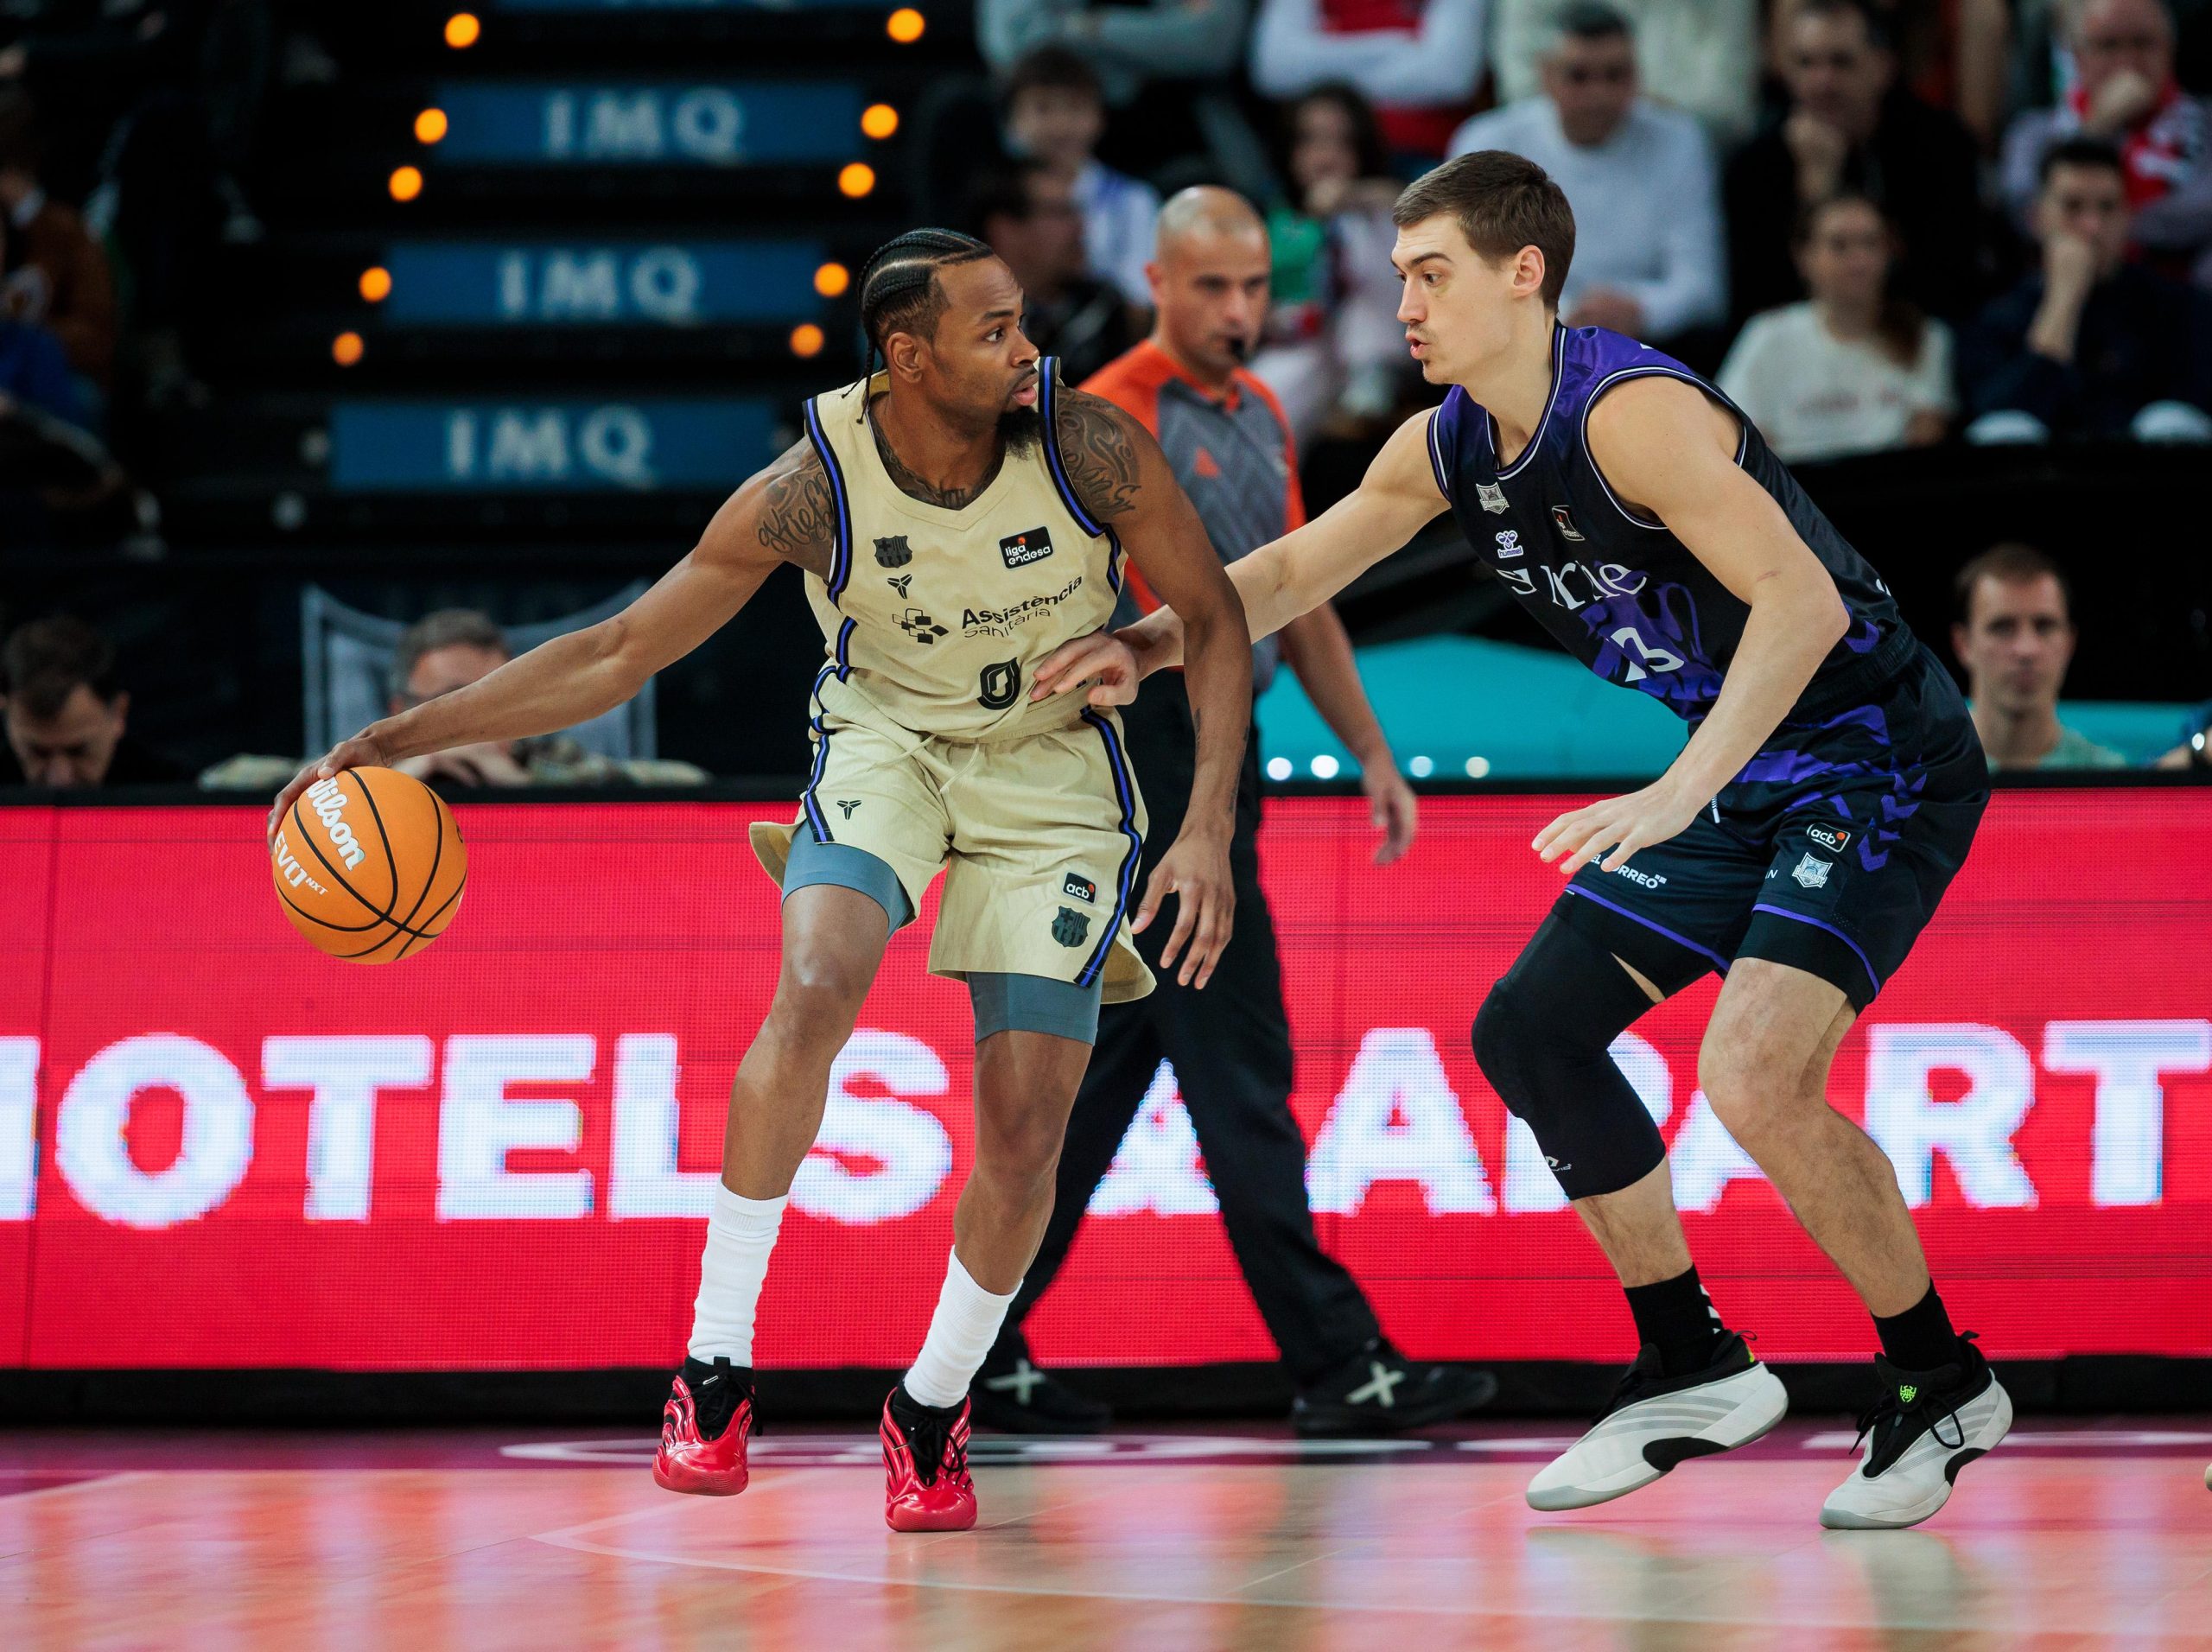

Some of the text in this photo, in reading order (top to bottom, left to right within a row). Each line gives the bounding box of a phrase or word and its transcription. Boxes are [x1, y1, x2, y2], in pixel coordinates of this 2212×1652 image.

[543, 87, 743, 166] IMQ
[499, 247, 700, 327] IMQ
[446, 405, 657, 491] IMQ
[1005, 544, 1026, 557] liga
[1008, 545, 1051, 565] endesa
[1498, 546, 1522, 558] hummel
[961, 575, 1083, 630] Assistència
[976, 656, 1022, 711] 0
[1810, 829, 1836, 845] acb
[1065, 883, 1090, 899] acb
[1611, 864, 1658, 889] RREO
[0, 1032, 954, 1228] OTELS
